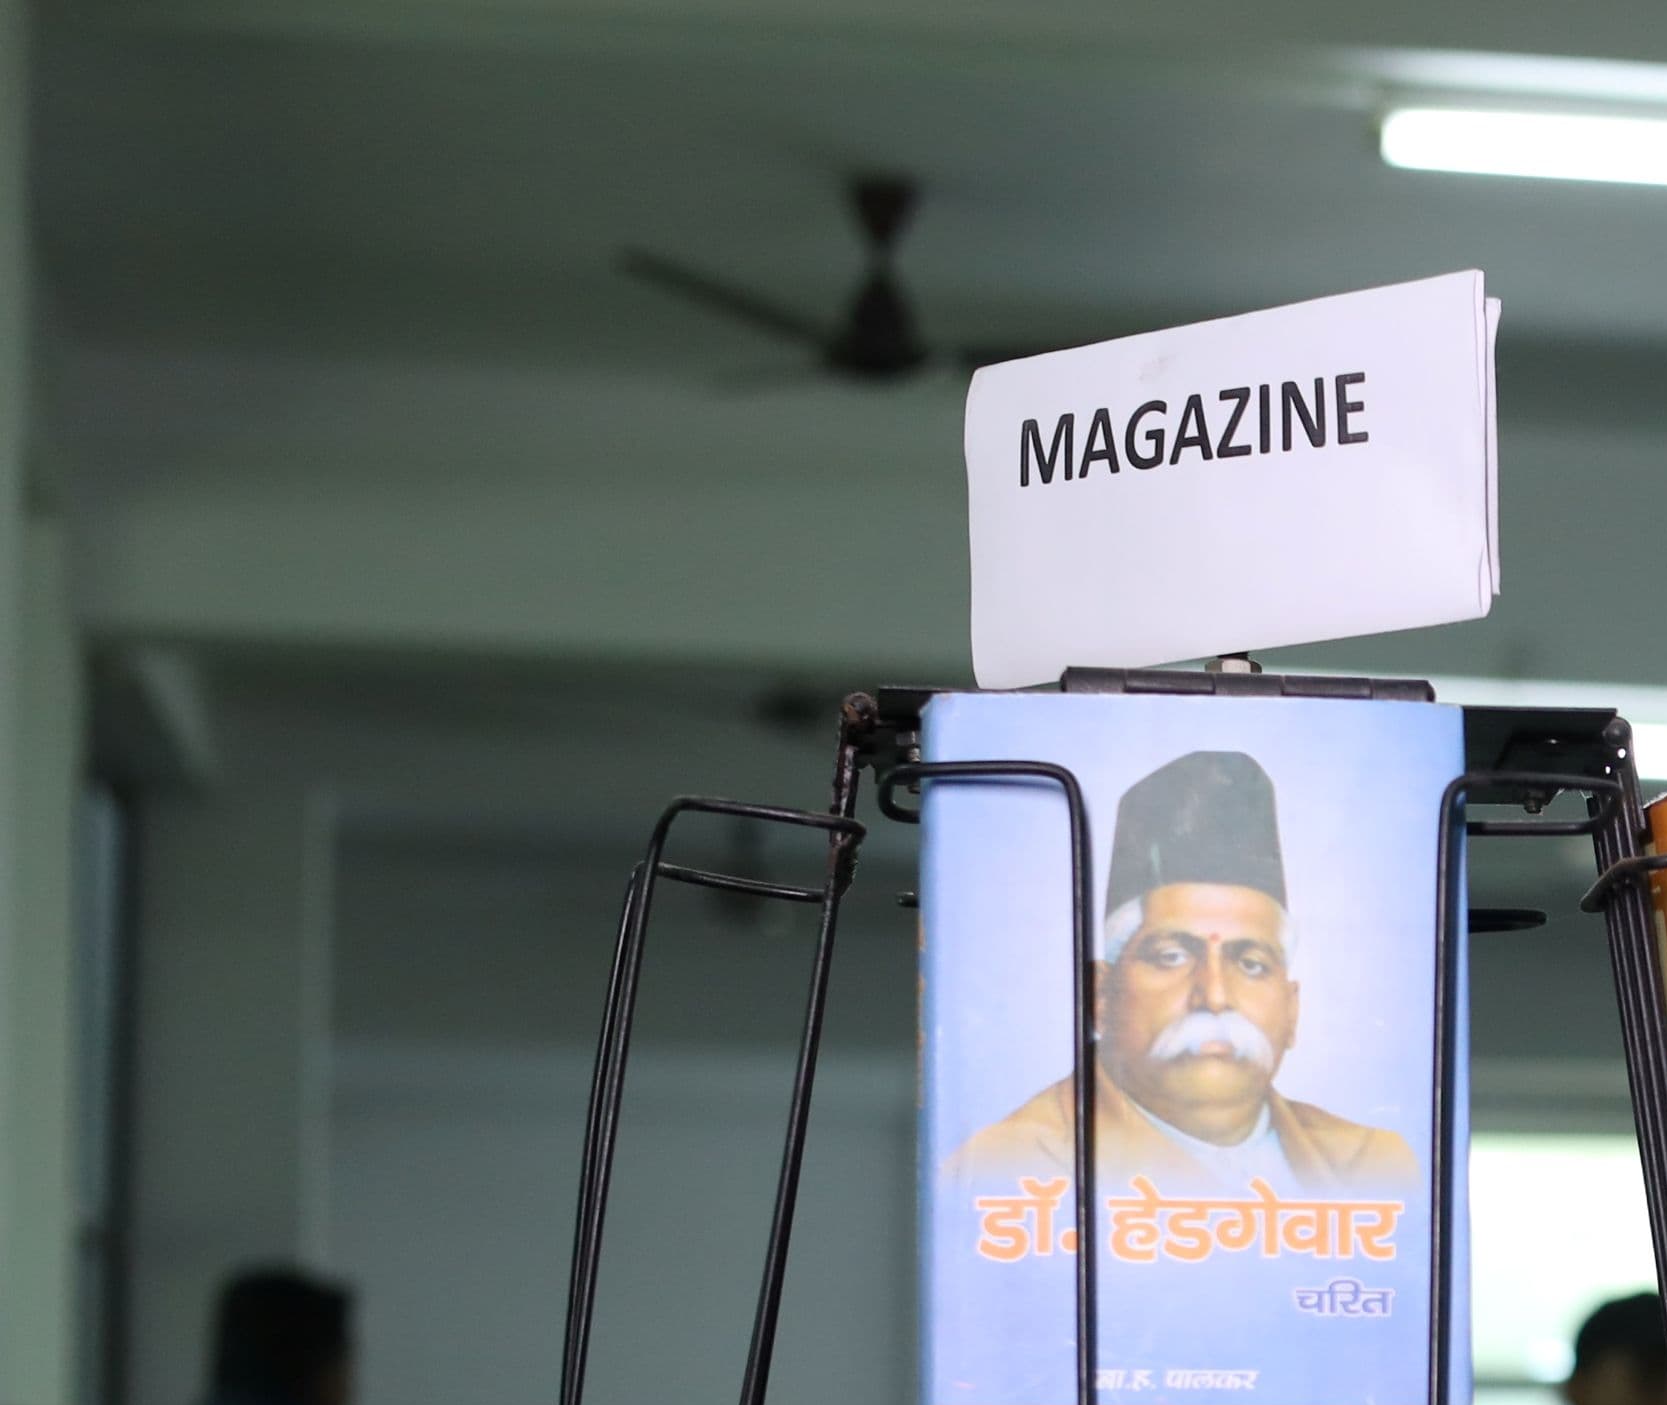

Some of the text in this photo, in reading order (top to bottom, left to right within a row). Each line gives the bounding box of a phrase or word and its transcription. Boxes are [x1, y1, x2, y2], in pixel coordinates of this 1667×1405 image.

[1020, 371, 1369, 487] MAGAZINE
[974, 1174, 1404, 1263] डॉ. हेडगेवार
[1296, 1280, 1394, 1315] चरित
[1165, 1369, 1259, 1391] पालकर
